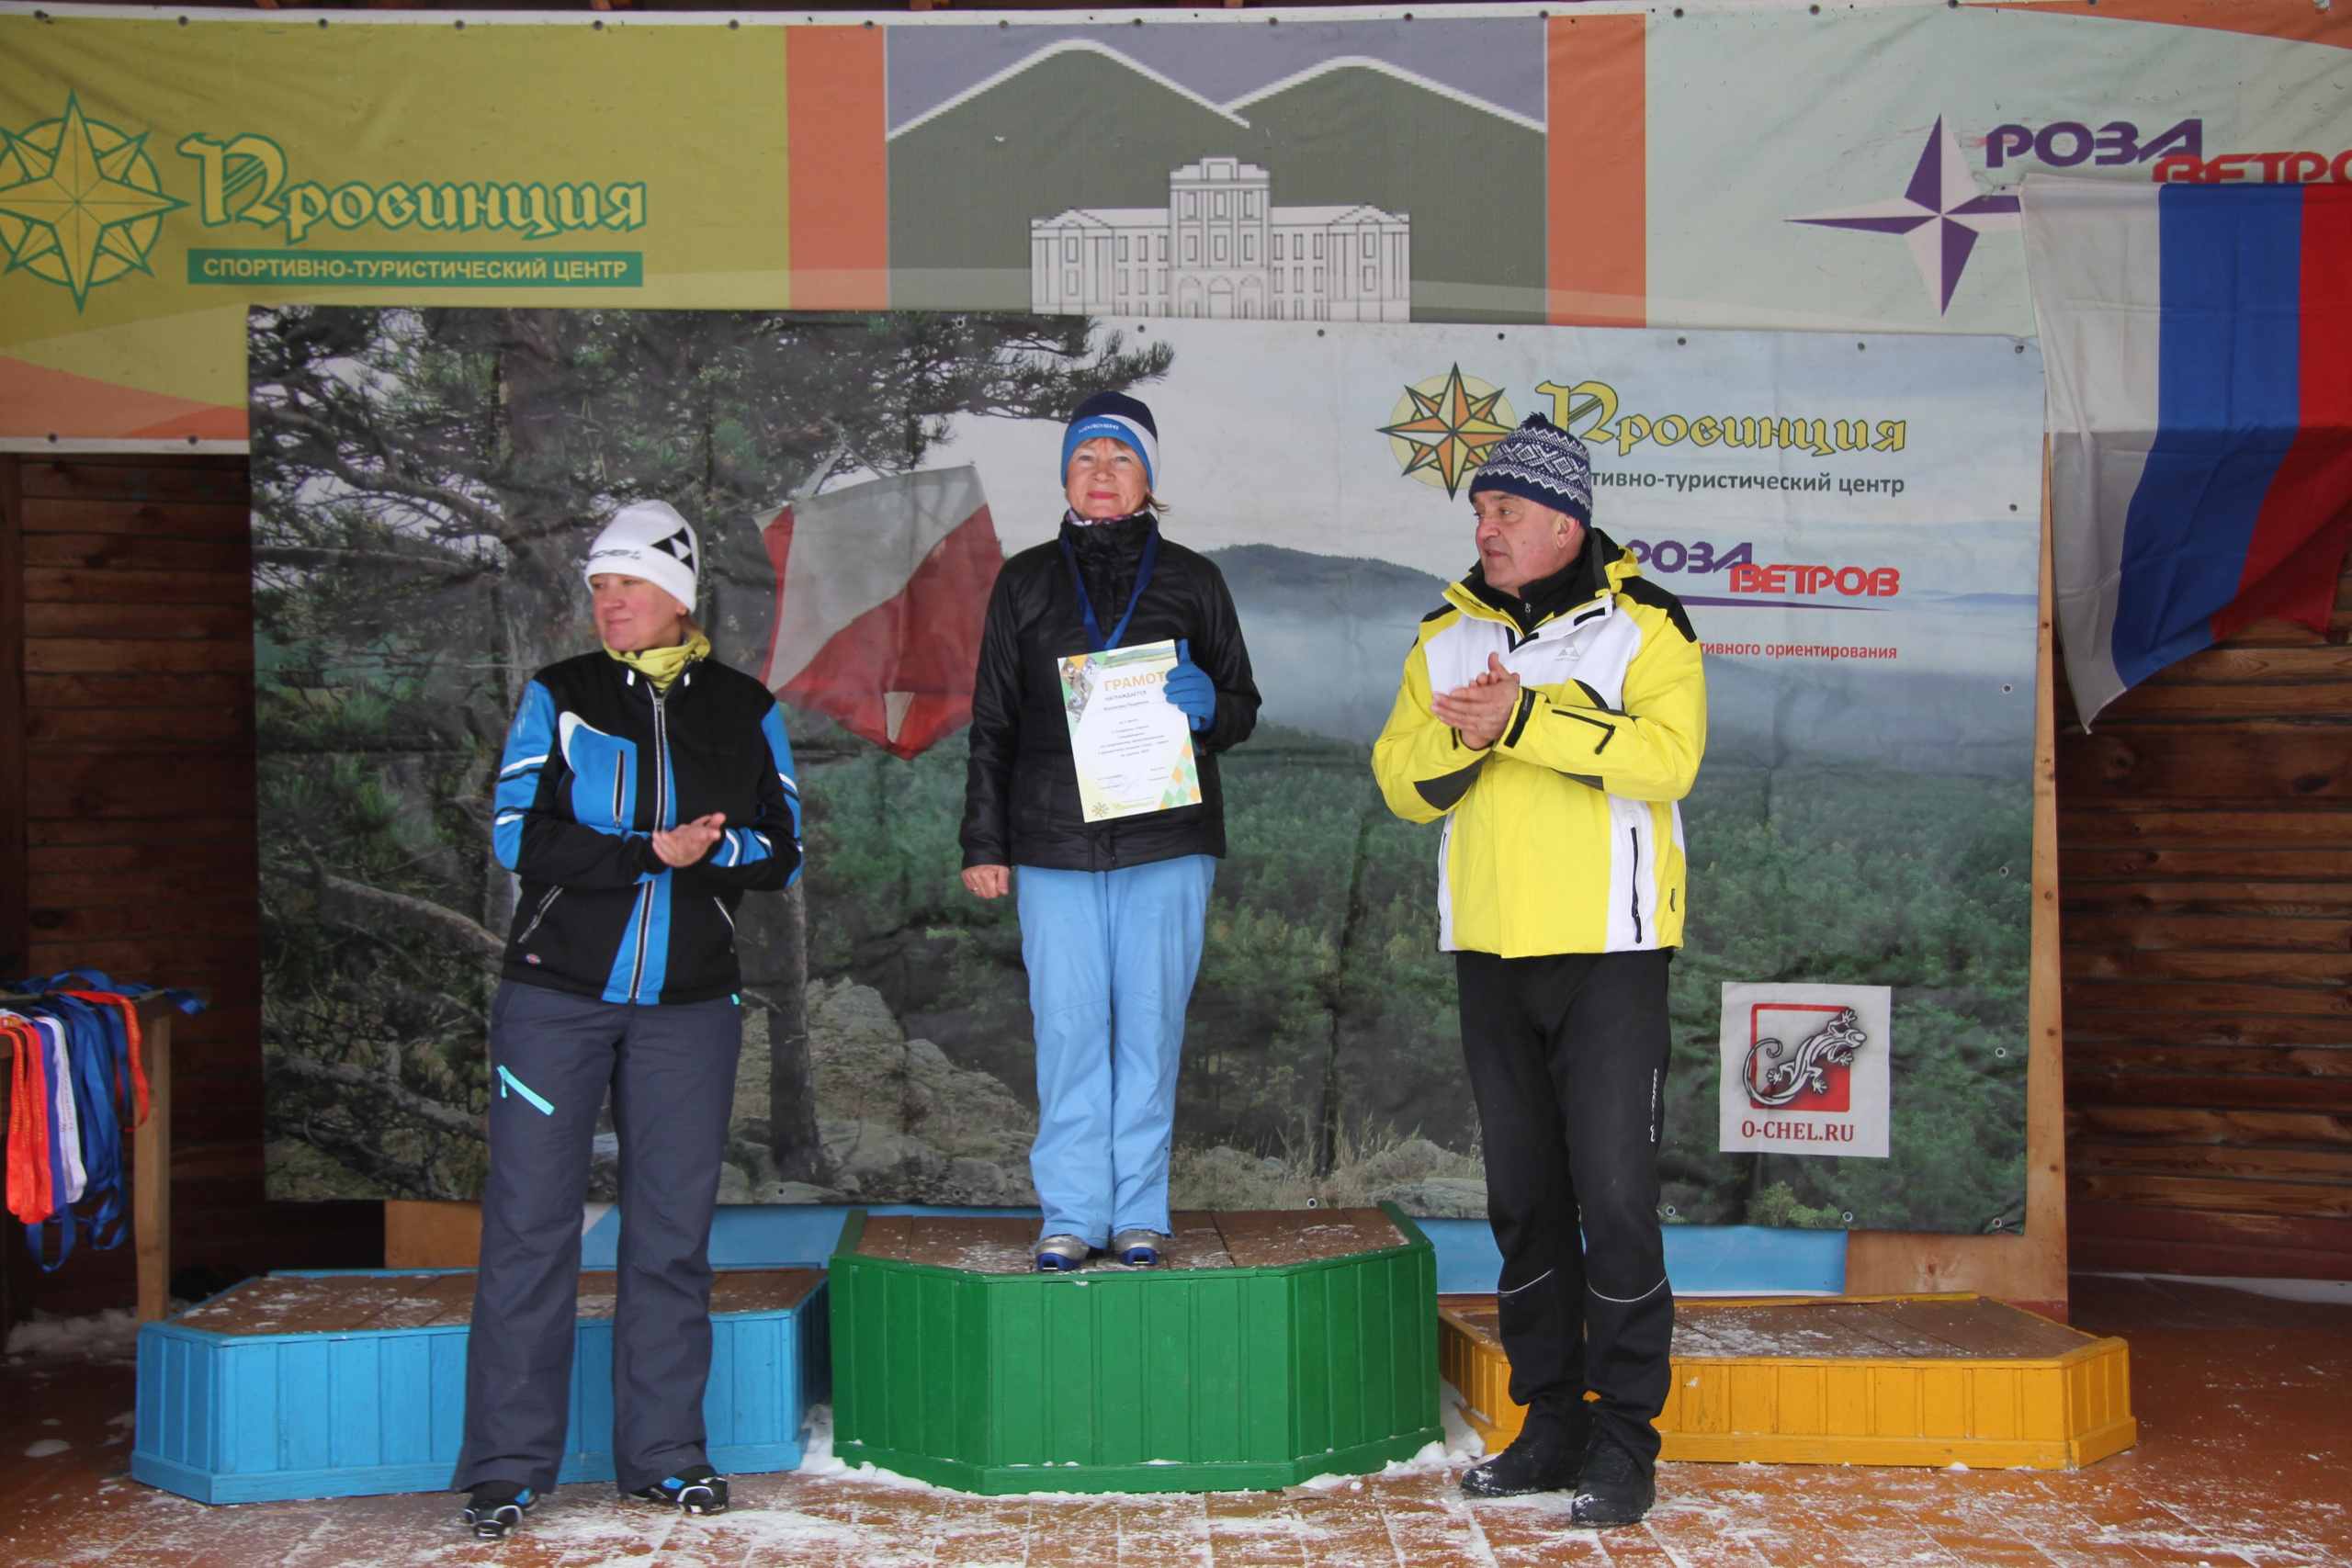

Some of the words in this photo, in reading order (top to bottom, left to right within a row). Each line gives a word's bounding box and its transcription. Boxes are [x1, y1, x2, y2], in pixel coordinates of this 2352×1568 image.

[1985, 118, 2203, 168] РОЗА
[176, 132, 648, 245] Провинция
[202, 256, 548, 280] СПОРТИВНО-ТУРИСТИЧЕСКИЙ
[553, 258, 628, 283] ЦЕНТР
[1534, 379, 1905, 457] Провинция
[1591, 470, 1831, 492] тивно-туристический
[1838, 473, 1905, 497] центр
[1729, 563, 1900, 597] ВЕТРОВ
[1700, 642, 1761, 656] тивного
[1765, 643, 1897, 660] ориентирования
[1103, 671, 1169, 692] ГРАМОТ
[1104, 690, 1147, 701] НАГРАЖДАЕТСЯ
[1741, 1120, 1855, 1142] O-CHEL.RU
